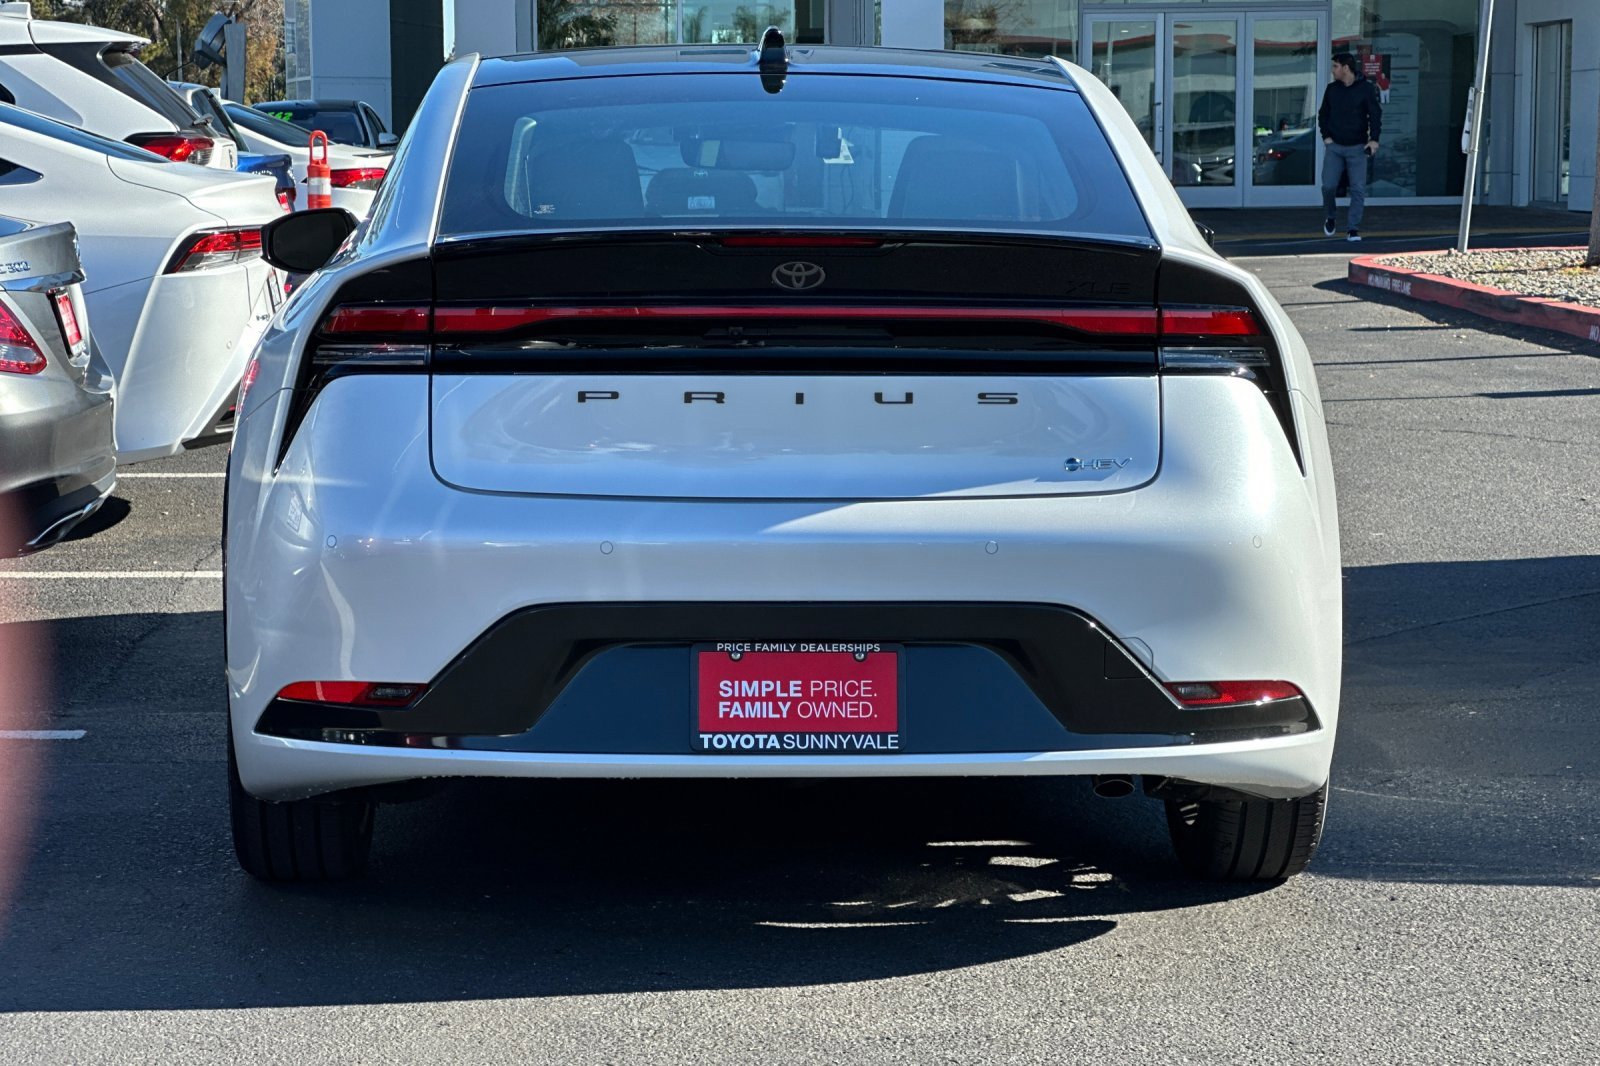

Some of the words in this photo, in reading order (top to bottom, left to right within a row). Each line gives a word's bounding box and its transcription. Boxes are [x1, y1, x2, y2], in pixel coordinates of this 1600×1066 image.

[6, 261, 31, 273] 300
[578, 390, 1018, 405] PRIUS
[716, 643, 751, 652] PRICE
[755, 643, 796, 652] FAMILY
[800, 643, 881, 652] DEALERSHIPS
[719, 680, 802, 697] SIMPLE
[810, 680, 878, 697] PRICE.
[718, 701, 791, 718] FAMILY
[797, 701, 878, 718] OWNED.
[699, 734, 781, 749] TOYOTA
[783, 734, 899, 749] SUNNYVALE
